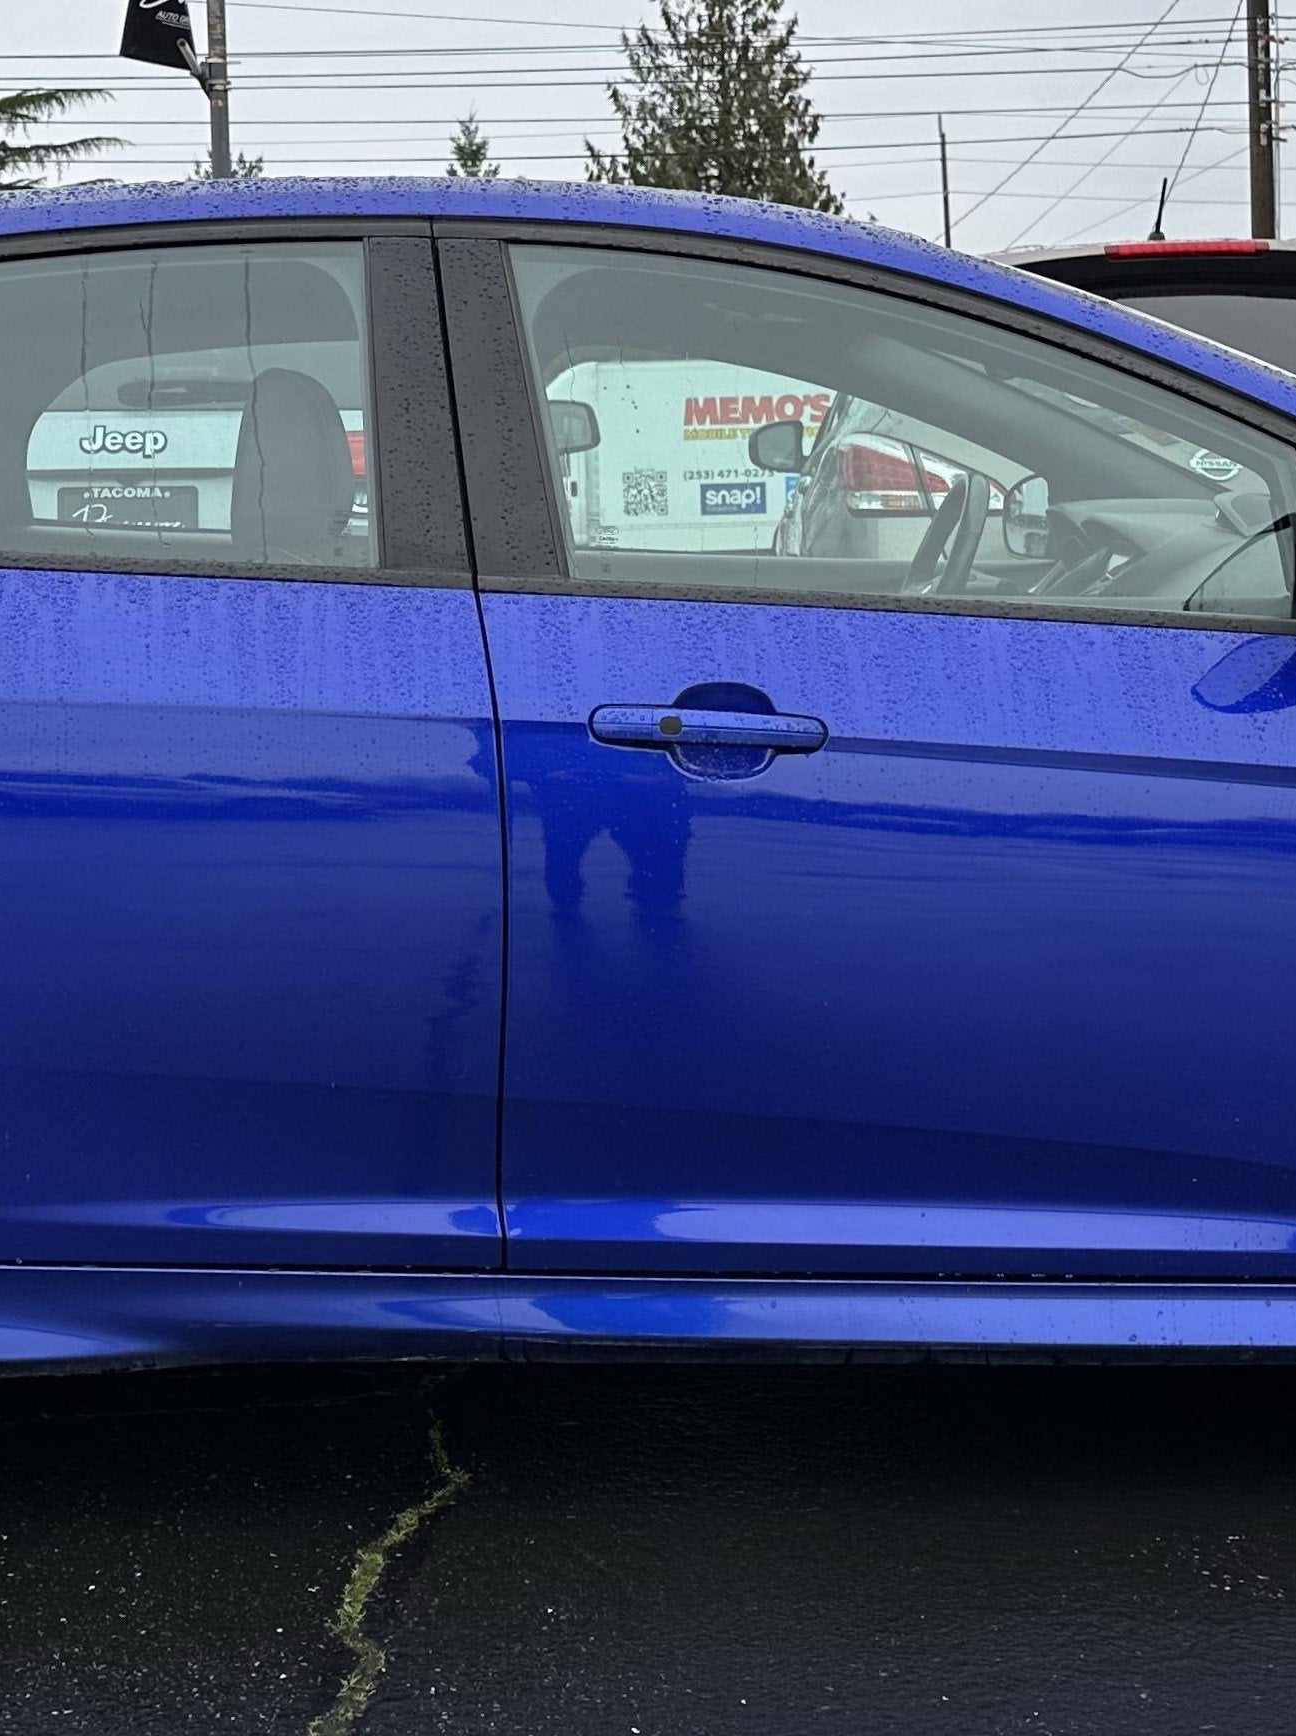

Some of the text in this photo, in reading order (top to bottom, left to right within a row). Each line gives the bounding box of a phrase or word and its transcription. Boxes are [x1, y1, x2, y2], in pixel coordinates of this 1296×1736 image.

[684, 394, 830, 426] MEMO'S
[79, 425, 168, 459] Jeep
[1195, 459, 1238, 468] NISSAN
[683, 470, 715, 481] (253)
[91, 487, 163, 499] TACOMA
[705, 486, 761, 508] snap!
